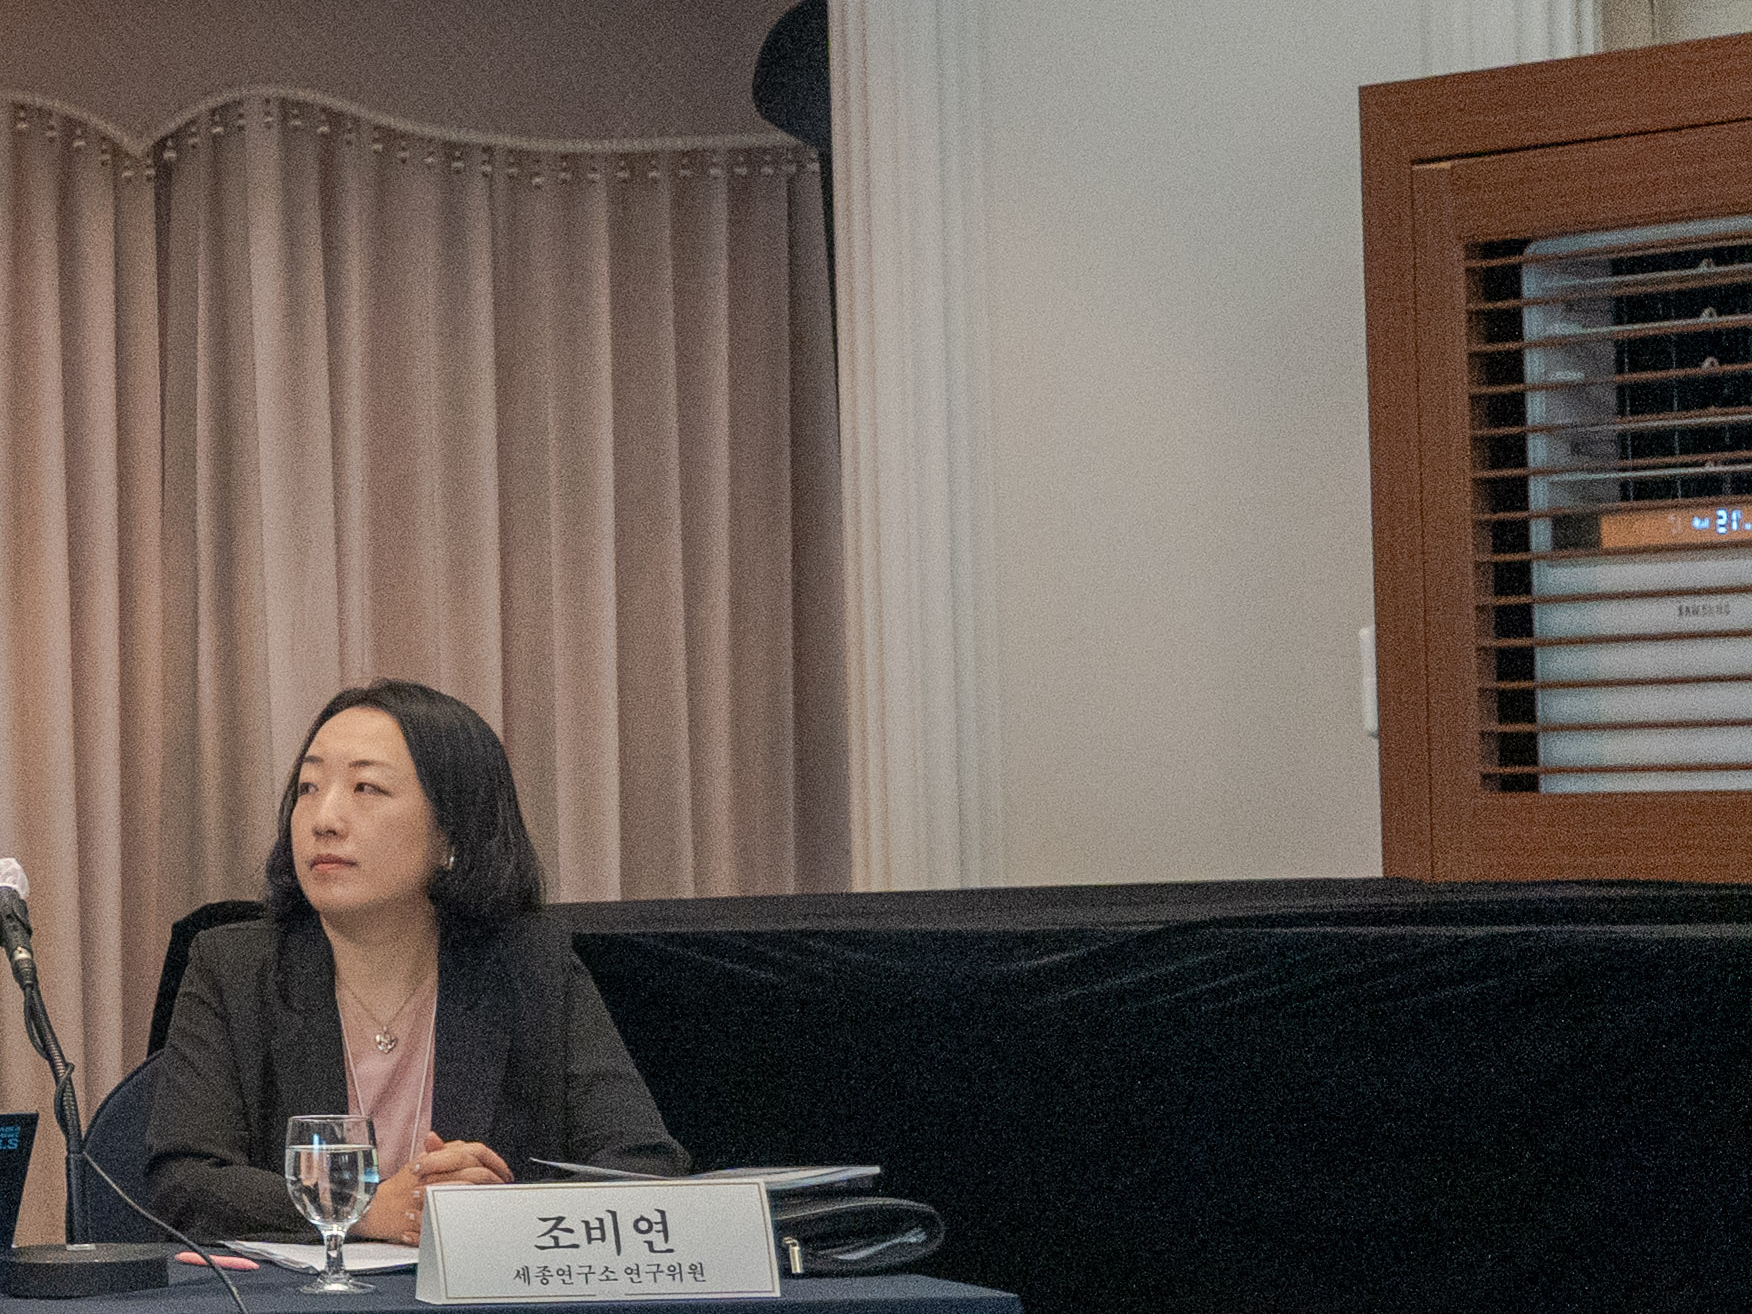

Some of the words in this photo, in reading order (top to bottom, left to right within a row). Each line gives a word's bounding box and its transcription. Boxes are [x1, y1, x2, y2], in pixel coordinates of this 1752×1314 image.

[534, 1208, 676, 1257] 조비연
[513, 1264, 619, 1287] 세종연구소
[623, 1261, 707, 1284] 연구위원
